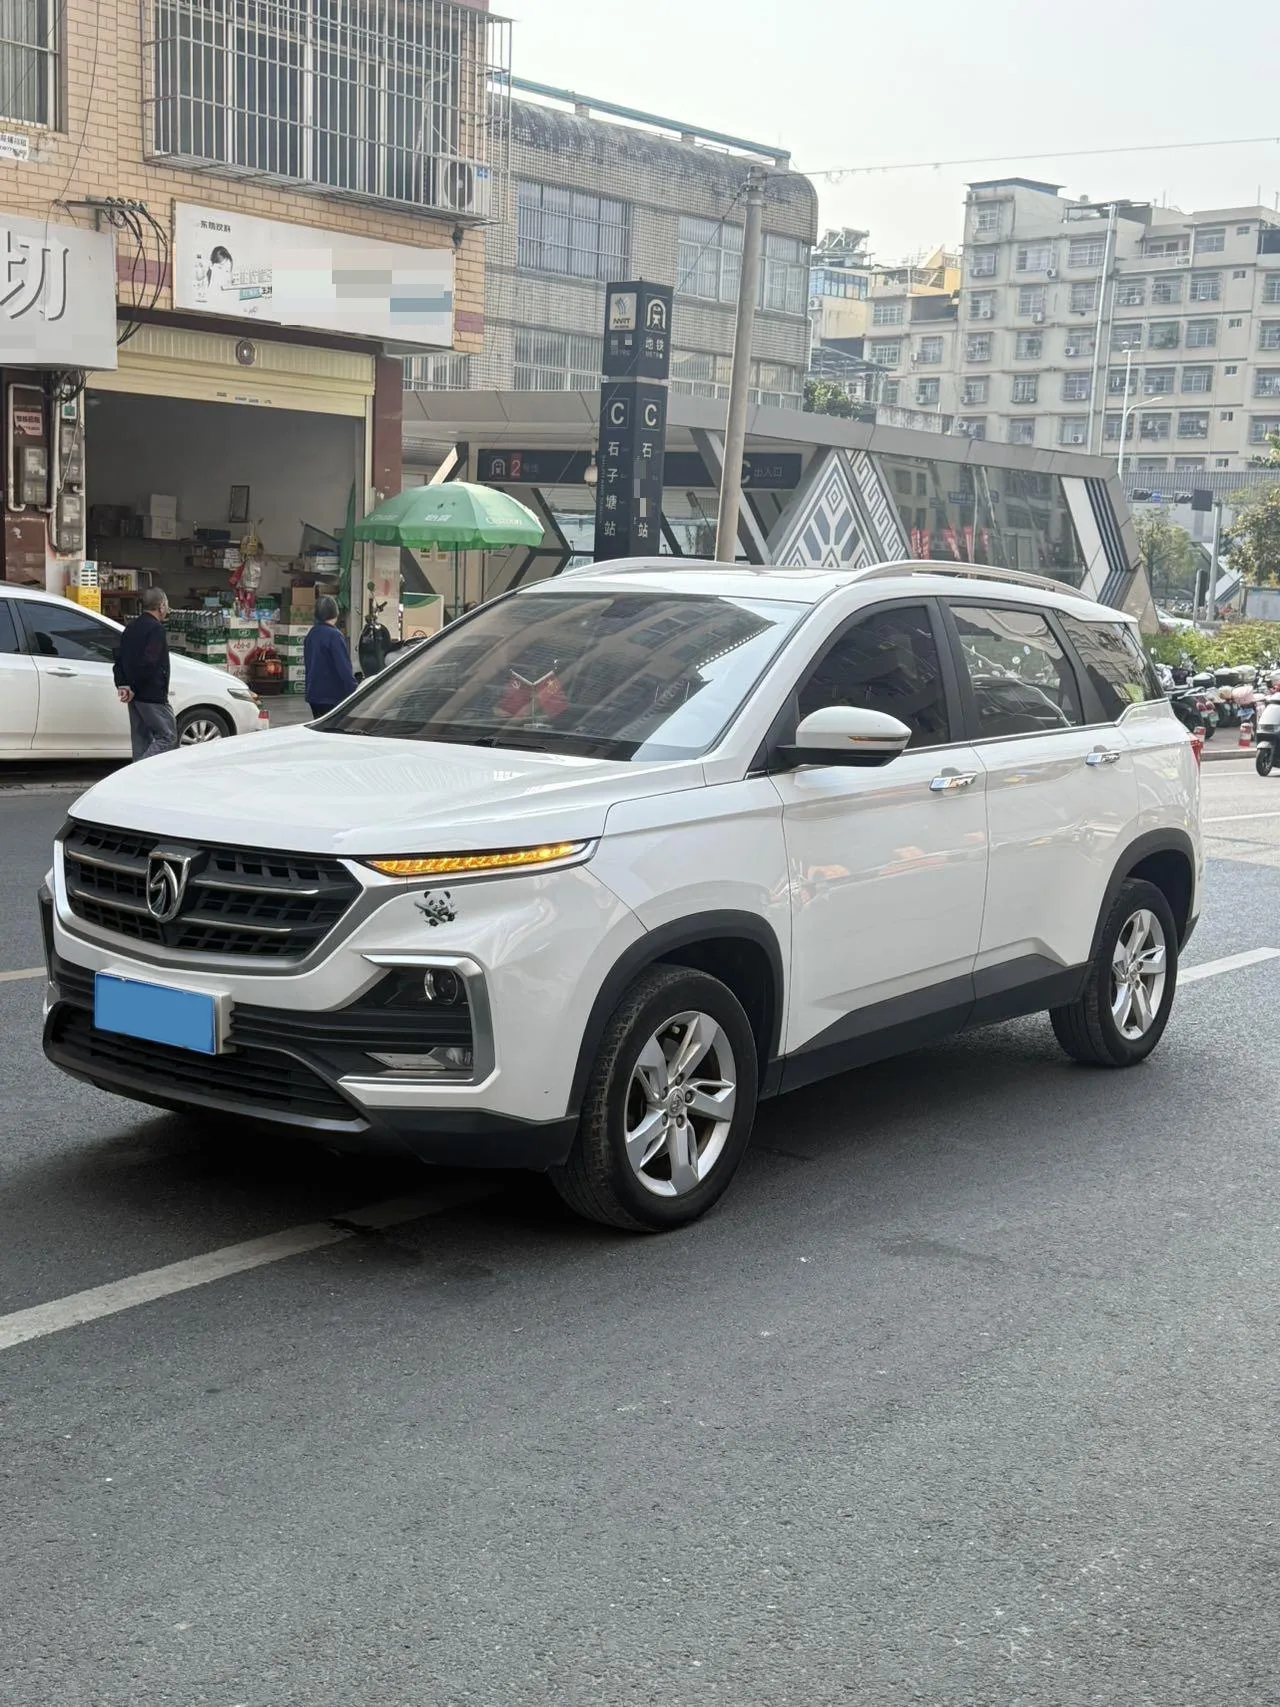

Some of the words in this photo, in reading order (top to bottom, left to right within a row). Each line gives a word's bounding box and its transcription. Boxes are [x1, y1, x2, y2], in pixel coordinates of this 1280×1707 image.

[645, 338, 664, 351] 地铁
[611, 402, 625, 424] C
[645, 404, 657, 426] C
[511, 460, 521, 476] 2
[753, 466, 784, 477] 出入口
[604, 441, 620, 537] 石子塘站
